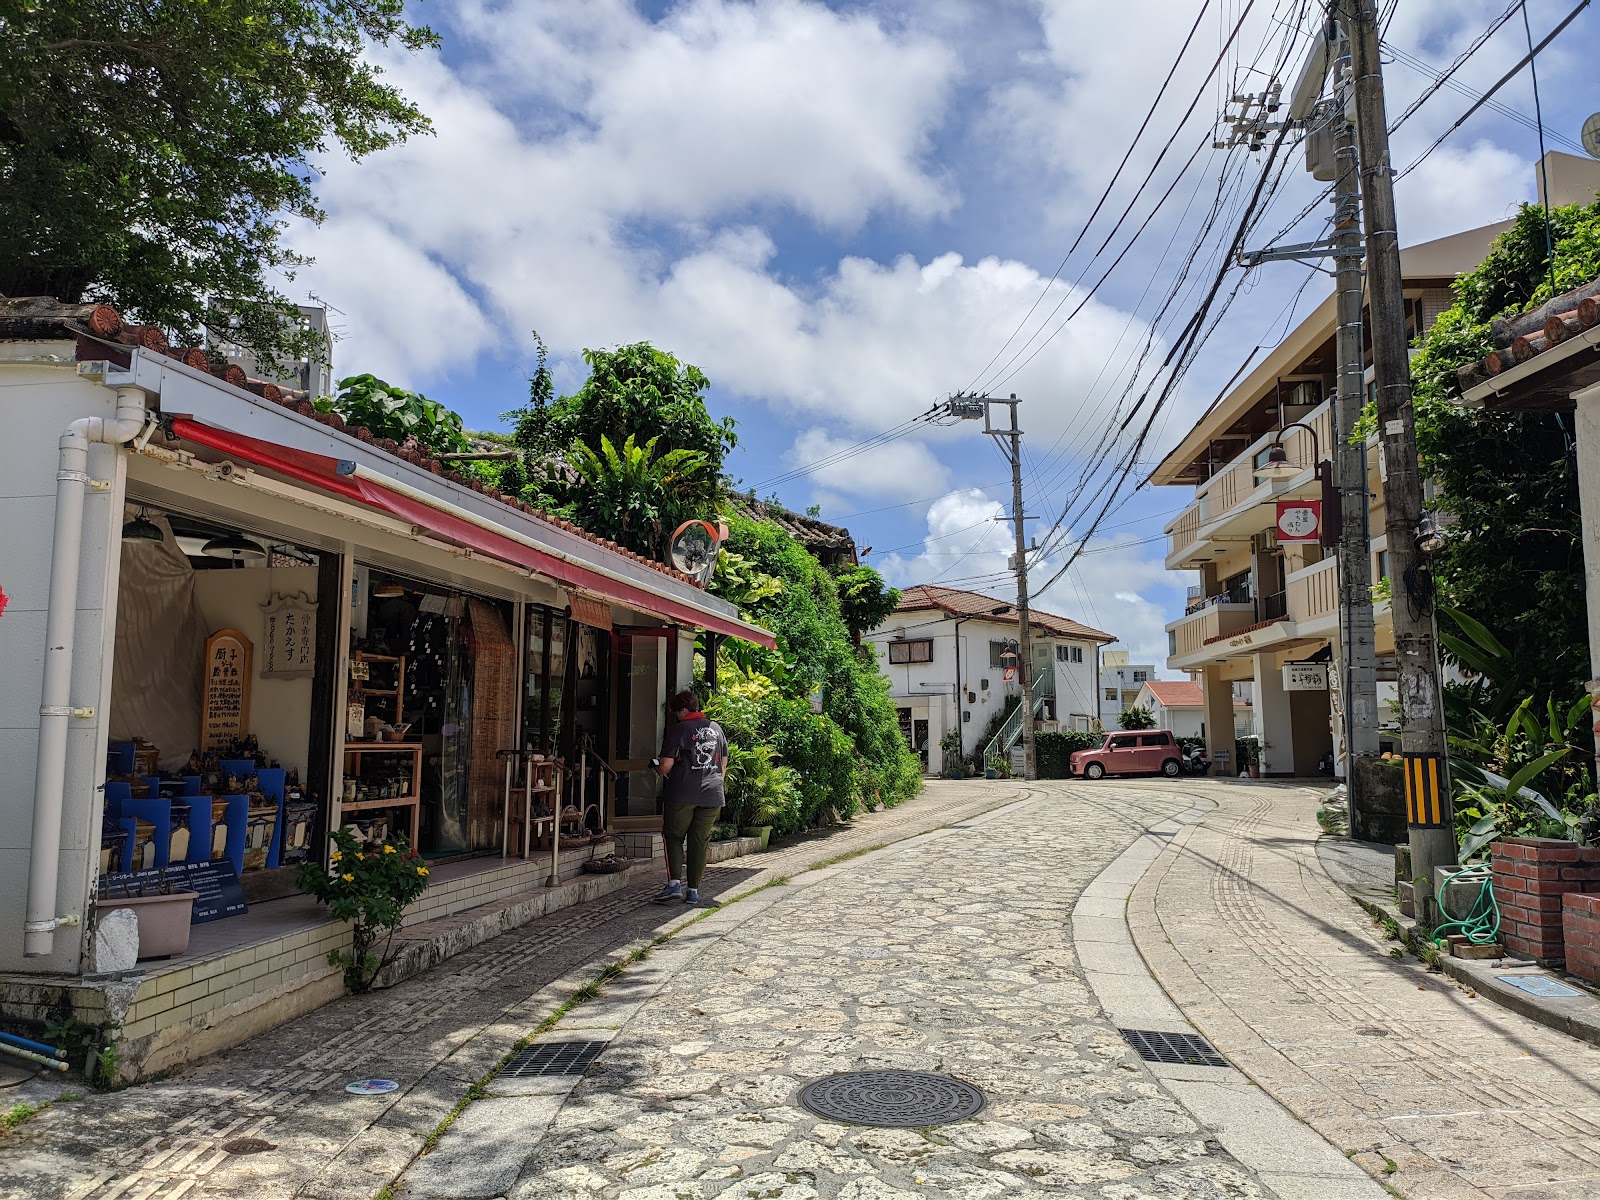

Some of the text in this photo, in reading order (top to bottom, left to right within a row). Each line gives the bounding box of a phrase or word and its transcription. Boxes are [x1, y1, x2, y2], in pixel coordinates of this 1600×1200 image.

[1286, 521, 1294, 534] 通り
[1294, 509, 1302, 533] やちむん
[285, 612, 296, 661] たかえす
